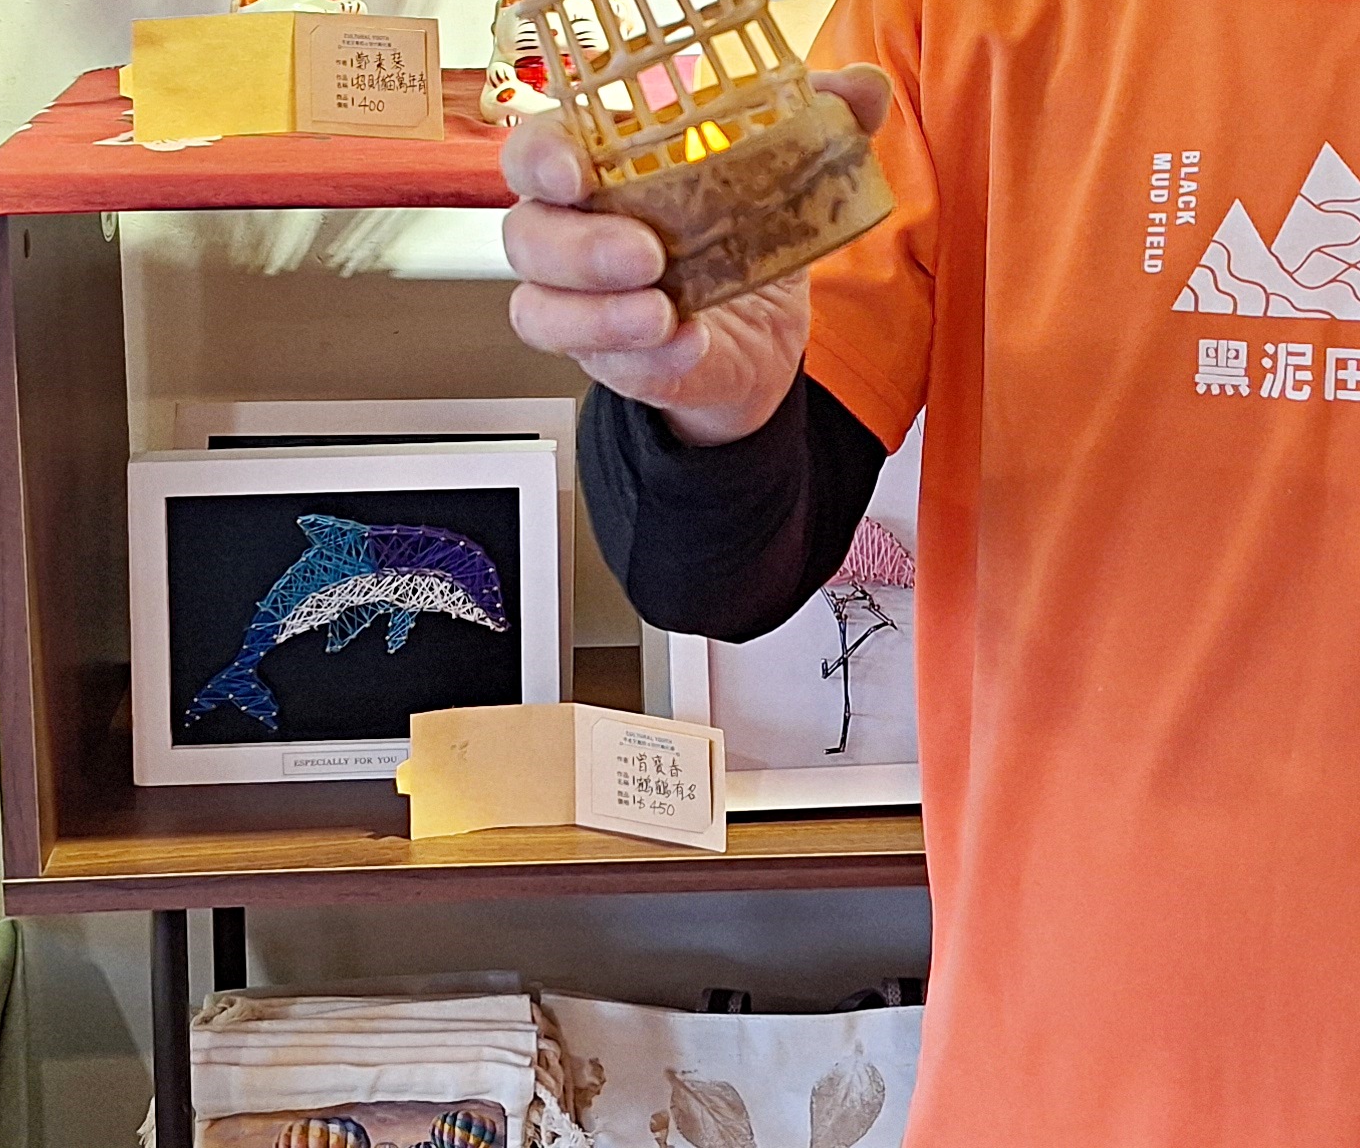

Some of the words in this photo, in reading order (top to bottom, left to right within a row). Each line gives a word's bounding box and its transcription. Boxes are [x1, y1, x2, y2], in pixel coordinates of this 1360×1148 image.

[358, 96, 386, 114] 400
[1149, 152, 1173, 205] MUD
[1175, 150, 1202, 226] BLACK
[1143, 212, 1168, 275] FIELD
[293, 758, 351, 768] ESPECIALLY
[353, 757, 374, 766] FOR
[377, 755, 398, 765] YOU
[649, 799, 676, 817] 450
